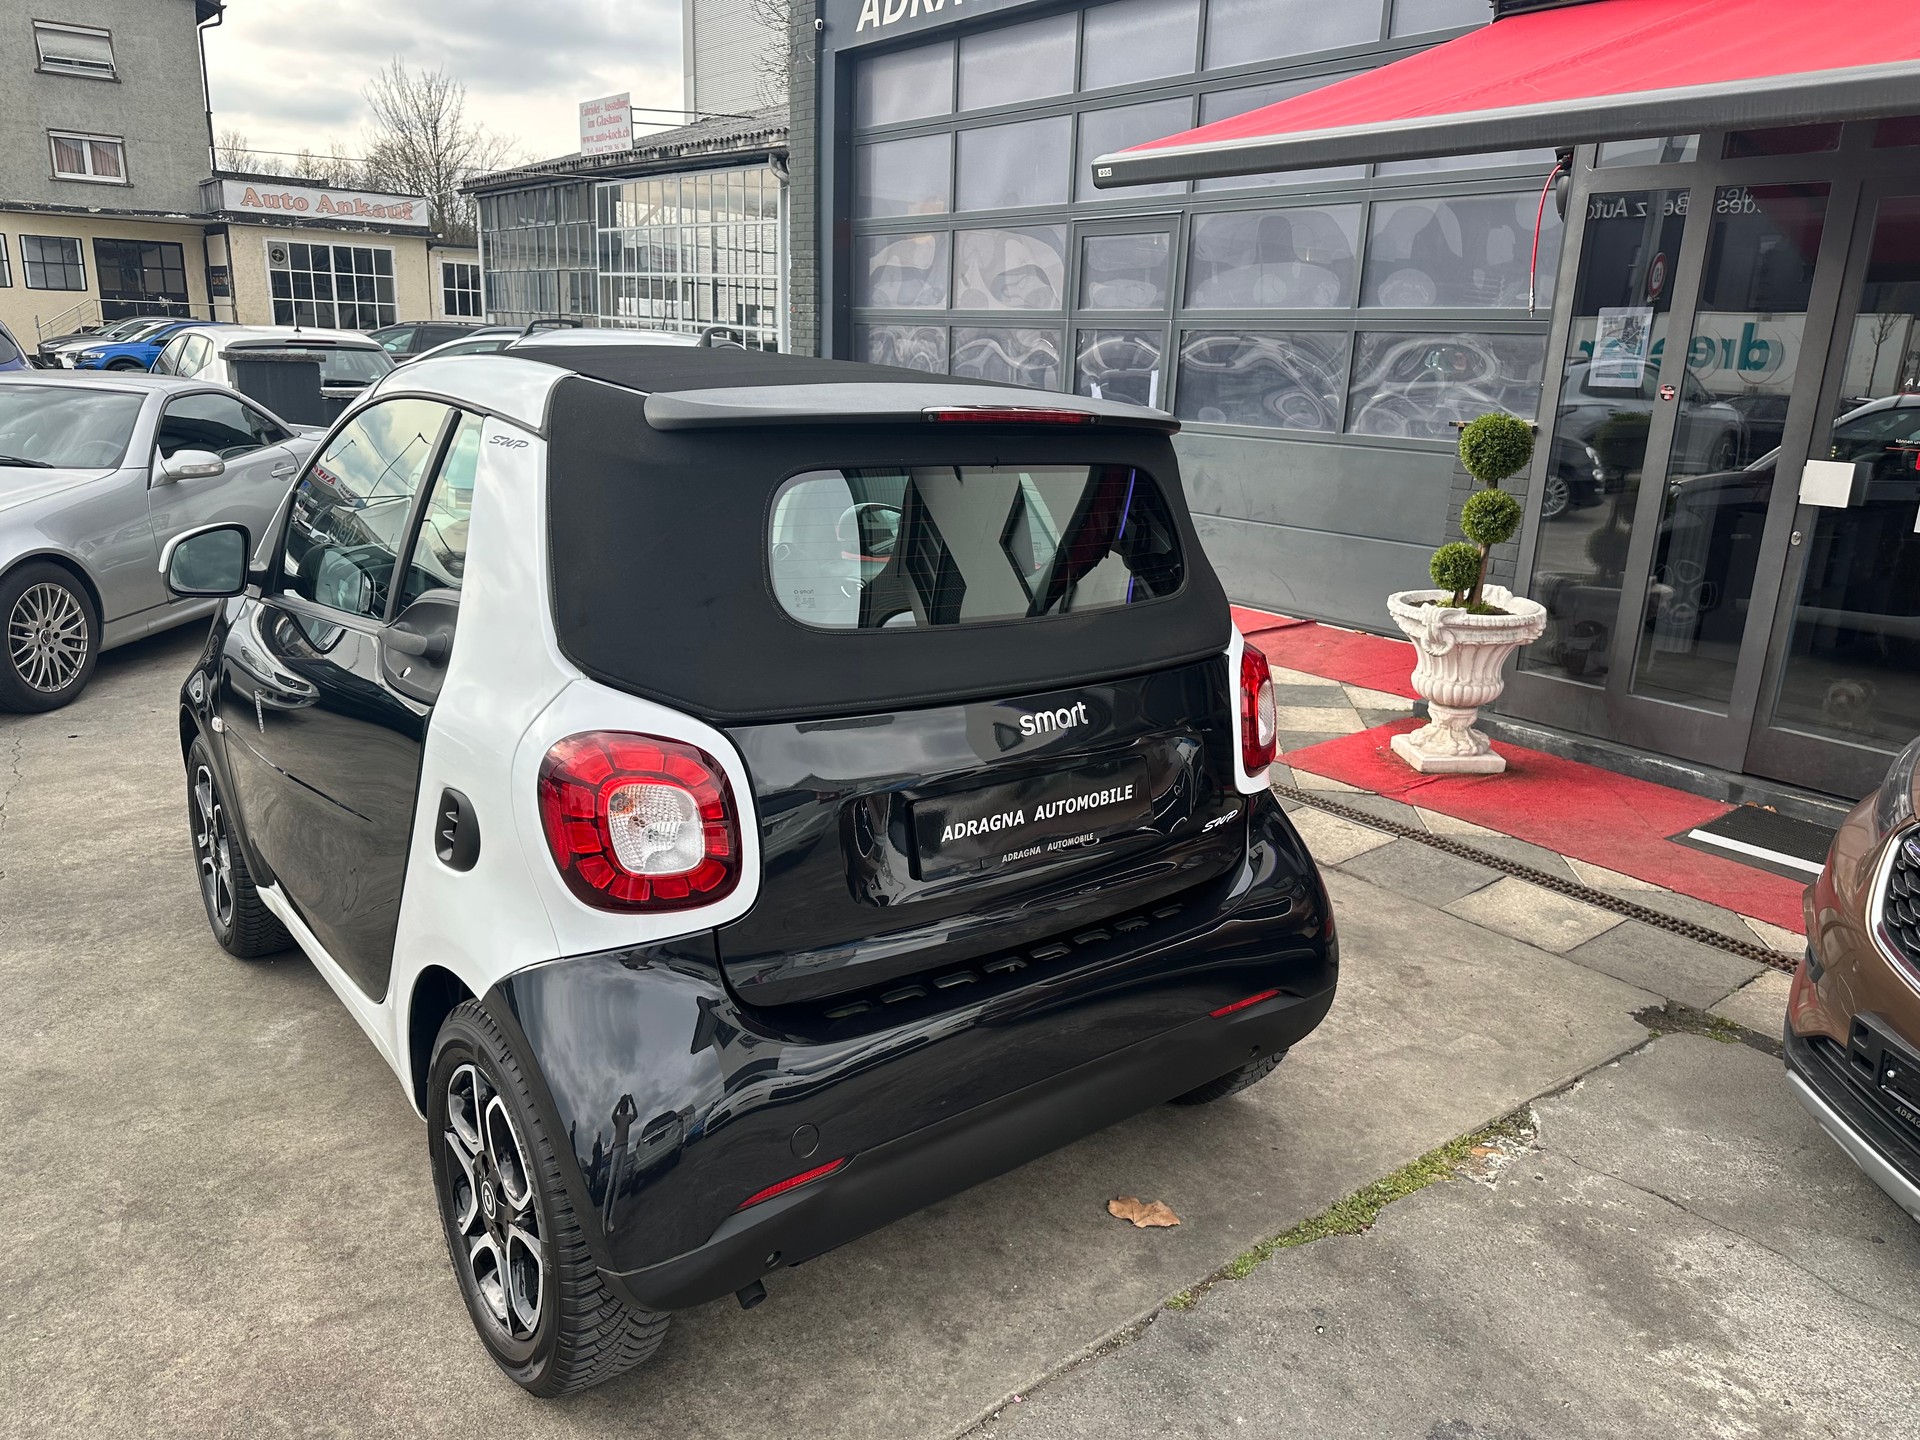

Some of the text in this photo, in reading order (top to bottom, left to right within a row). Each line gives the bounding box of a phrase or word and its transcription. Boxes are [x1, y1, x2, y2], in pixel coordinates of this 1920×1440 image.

[856, 0, 962, 32] ADR
[597, 114, 622, 127] Glashaus
[241, 187, 413, 220] Auto Ankauf
[1019, 702, 1089, 736] smart
[941, 784, 1134, 842] ADRAGNA AUTOMOBILE
[1002, 831, 1095, 863] ADRAGNA AUTOMOBILE
[1894, 1106, 1920, 1128] ADRAG
